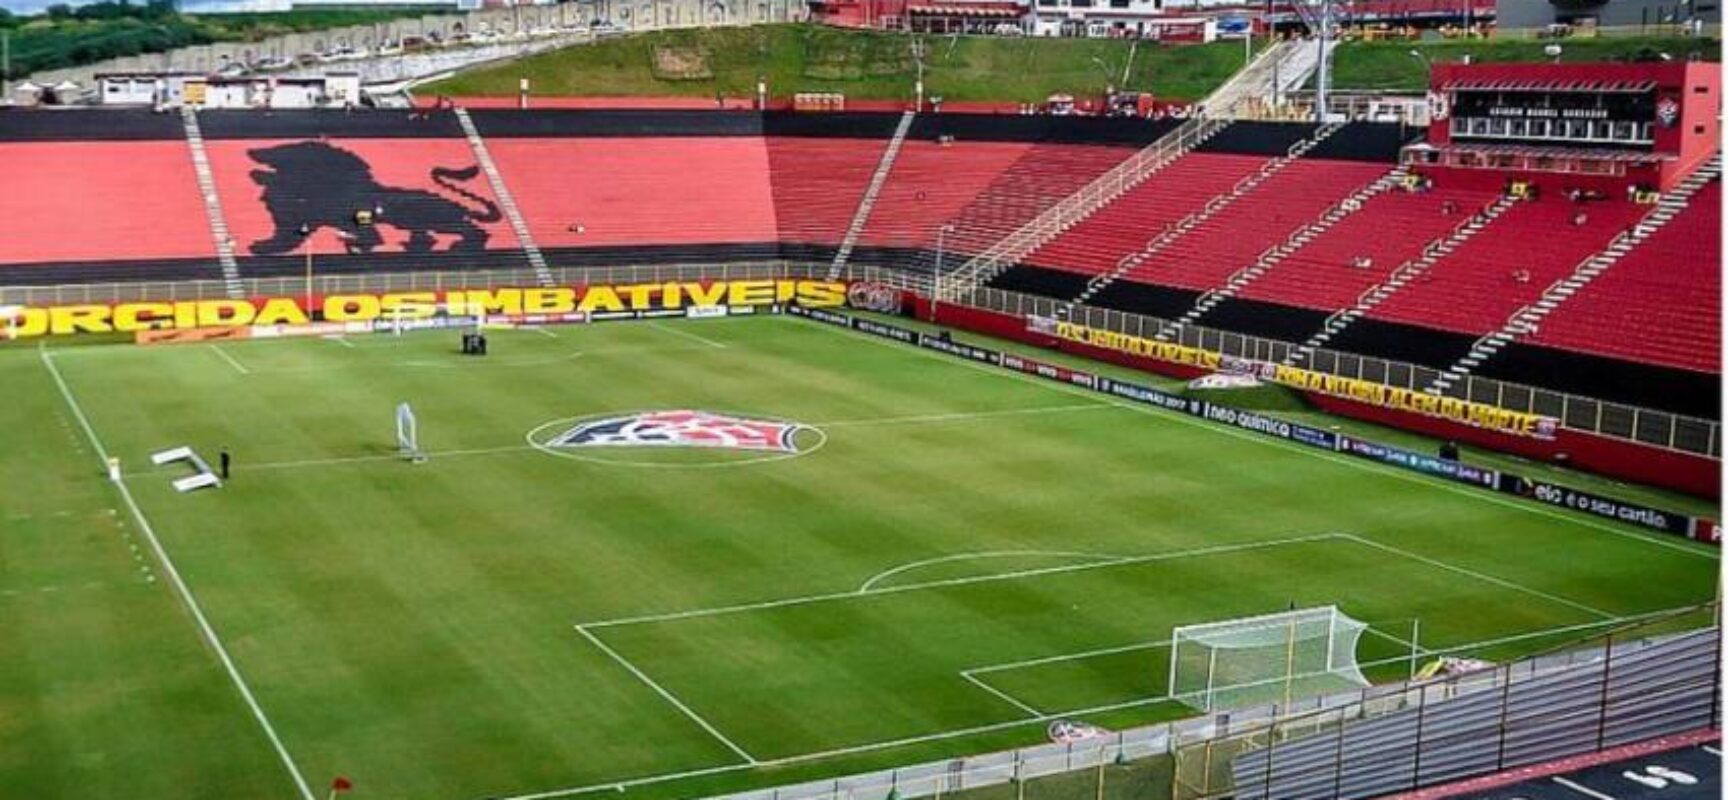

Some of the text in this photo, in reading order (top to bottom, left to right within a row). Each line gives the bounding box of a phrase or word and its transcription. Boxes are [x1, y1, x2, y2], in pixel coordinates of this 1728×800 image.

[323, 291, 437, 321] OS
[1211, 404, 1237, 424] neo
[1535, 484, 1562, 503] elo
[1578, 496, 1588, 509] o
[1590, 500, 1615, 517] seu
